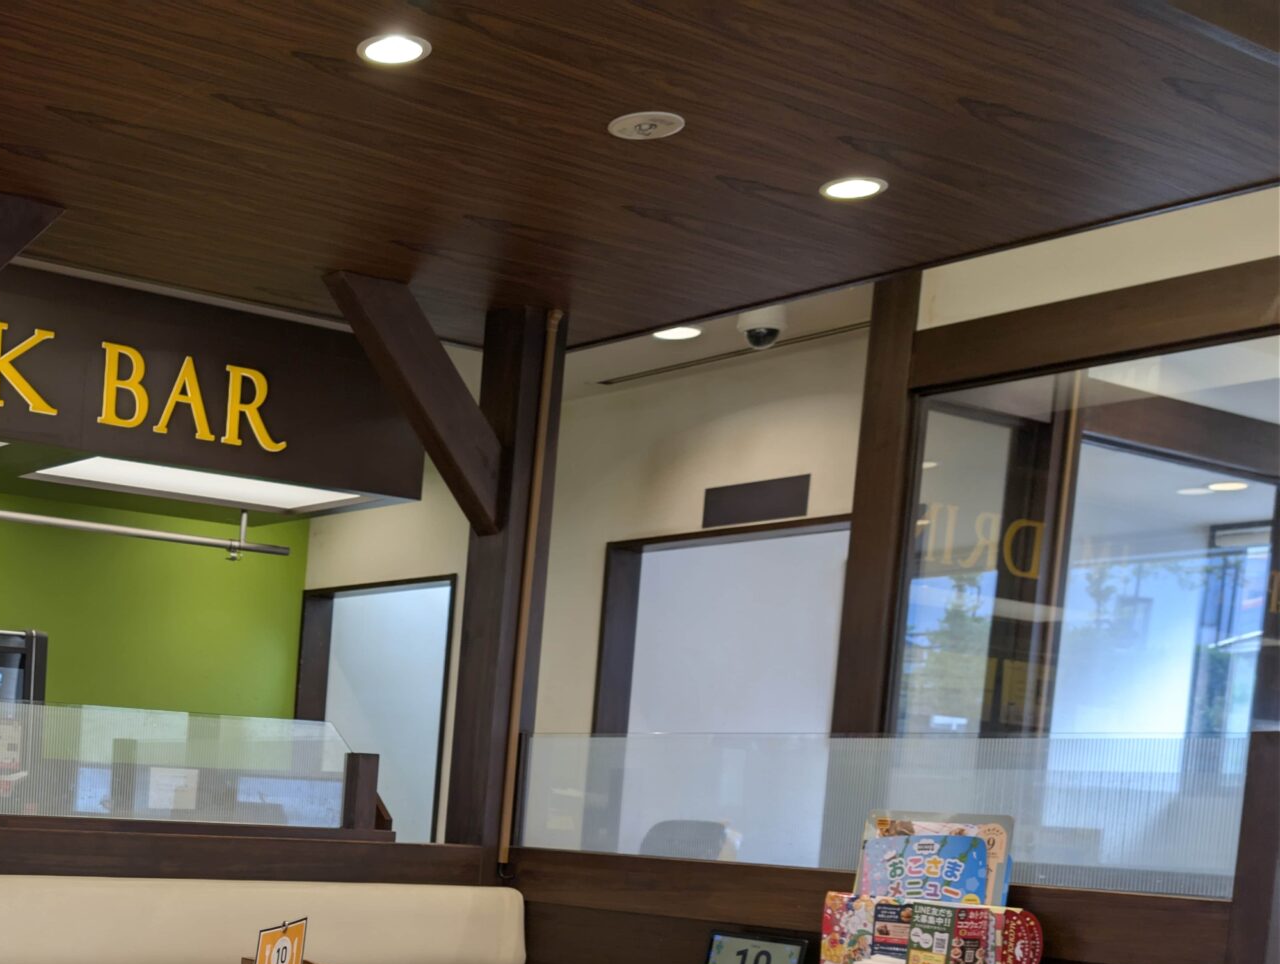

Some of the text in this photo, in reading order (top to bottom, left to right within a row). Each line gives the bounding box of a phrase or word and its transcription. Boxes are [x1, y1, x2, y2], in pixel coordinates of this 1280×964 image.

[96, 340, 289, 454] BAR
[887, 857, 964, 881] おこさま
[889, 881, 961, 899] メニュー
